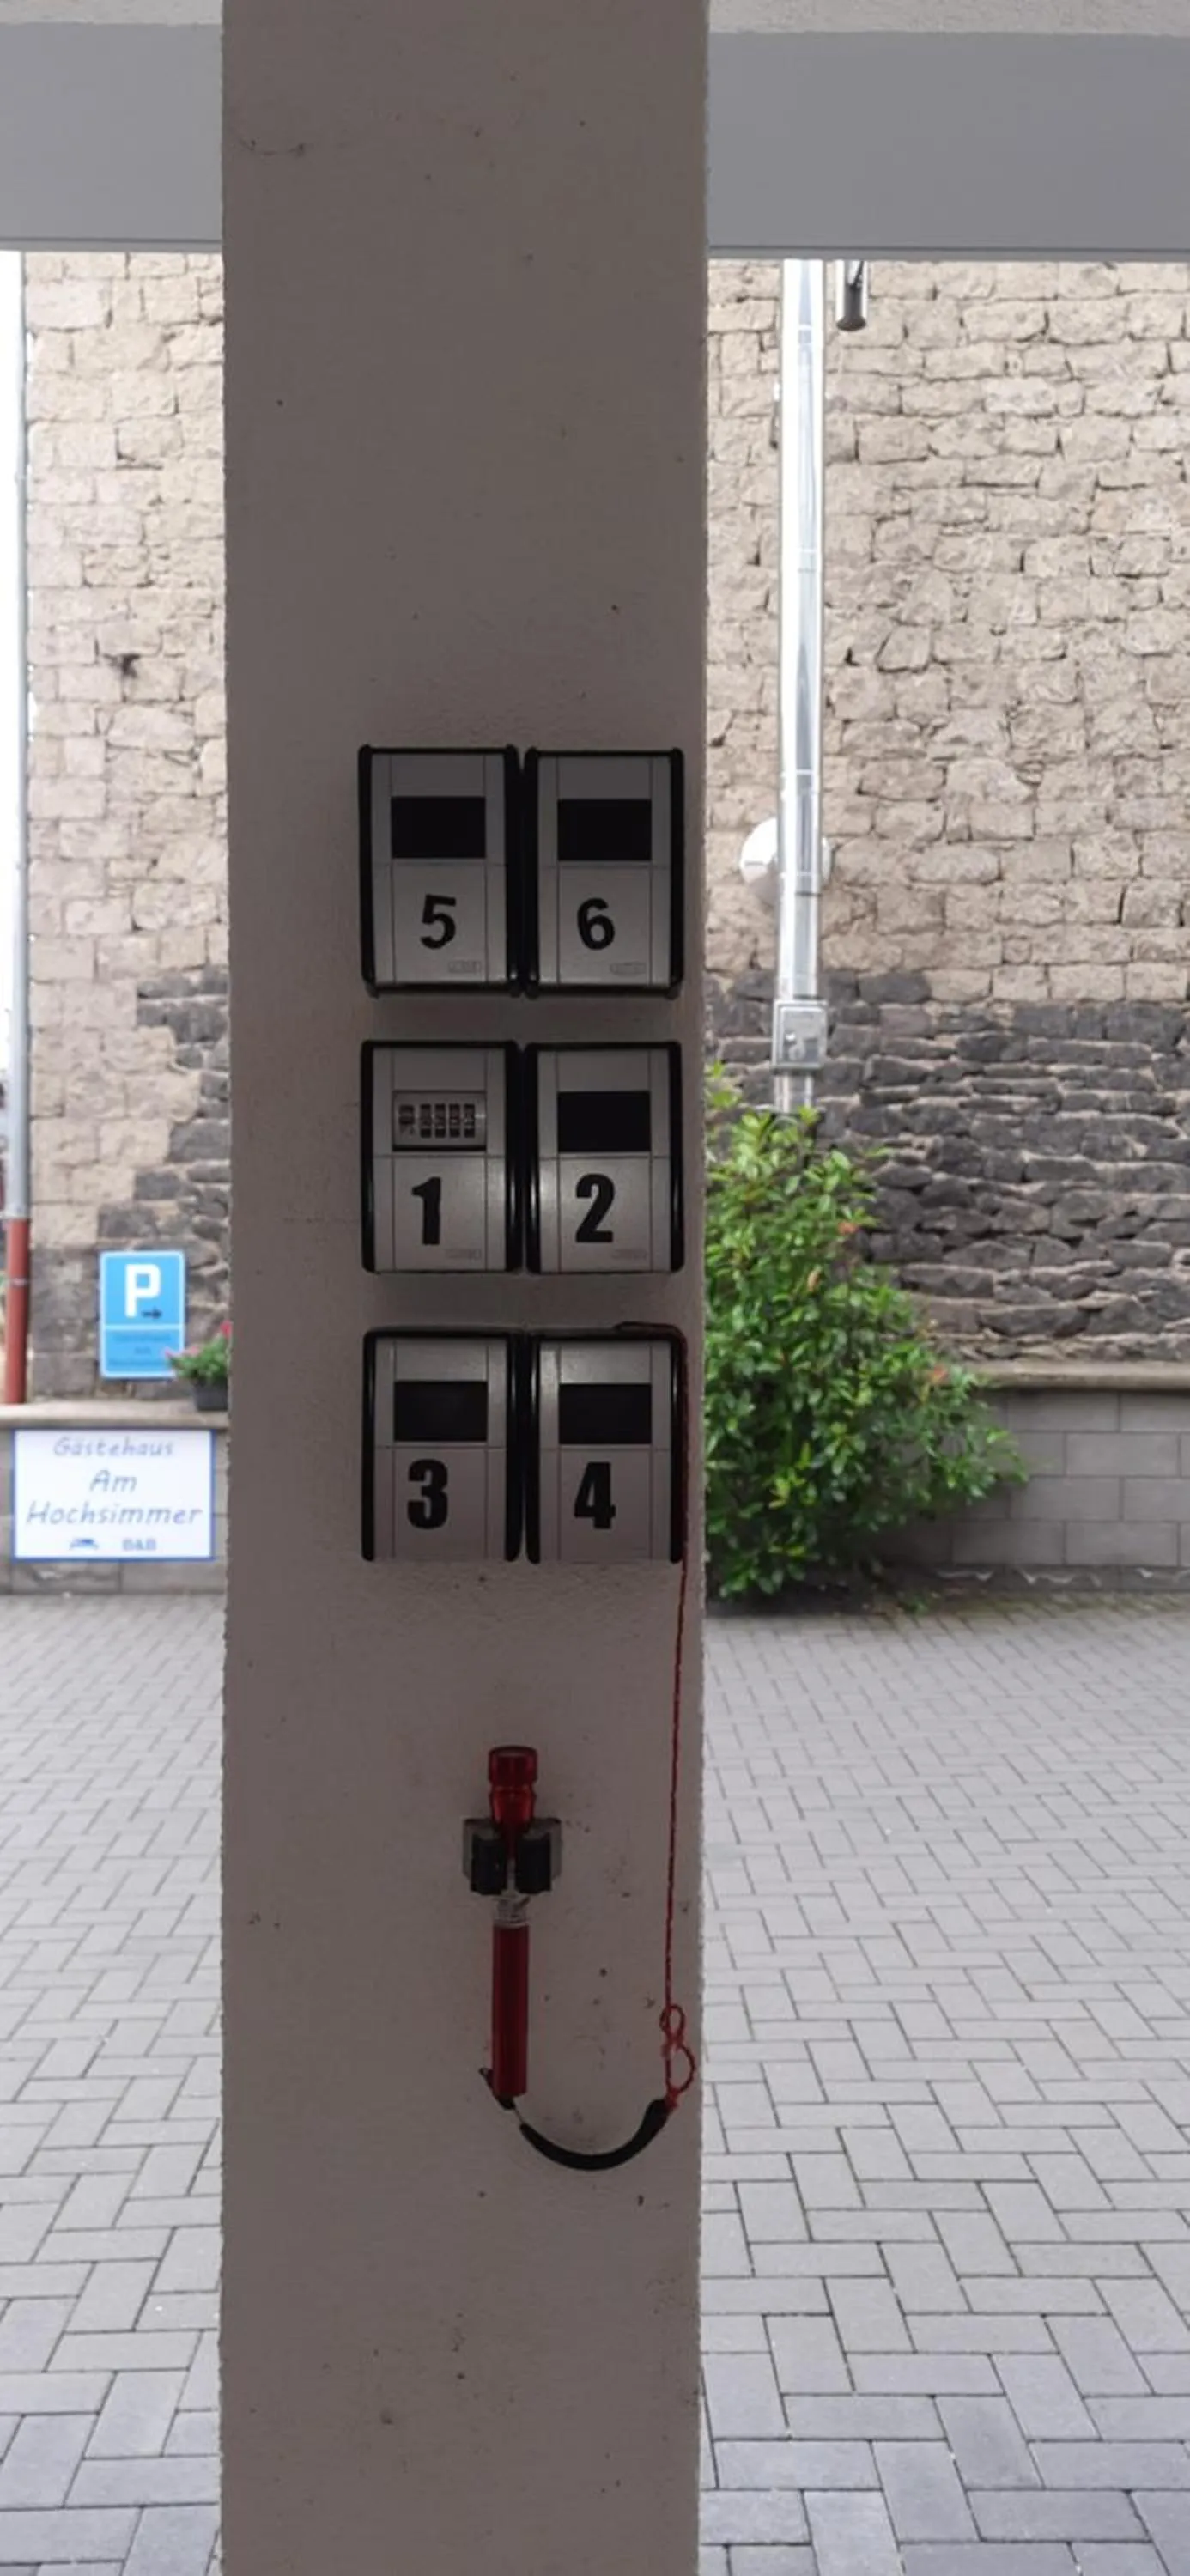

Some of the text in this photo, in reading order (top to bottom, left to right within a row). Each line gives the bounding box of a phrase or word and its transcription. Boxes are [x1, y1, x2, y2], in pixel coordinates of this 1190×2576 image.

[420, 893, 457, 950] 5
[576, 897, 616, 951] 6
[411, 1176, 442, 1246] 1
[575, 1173, 615, 1243] 2
[124, 1263, 161, 1318] P
[89, 1469, 137, 1492] Am
[407, 1459, 448, 1530] 3
[574, 1461, 616, 1530] 4
[26, 1501, 203, 1525] Hochsimmer
